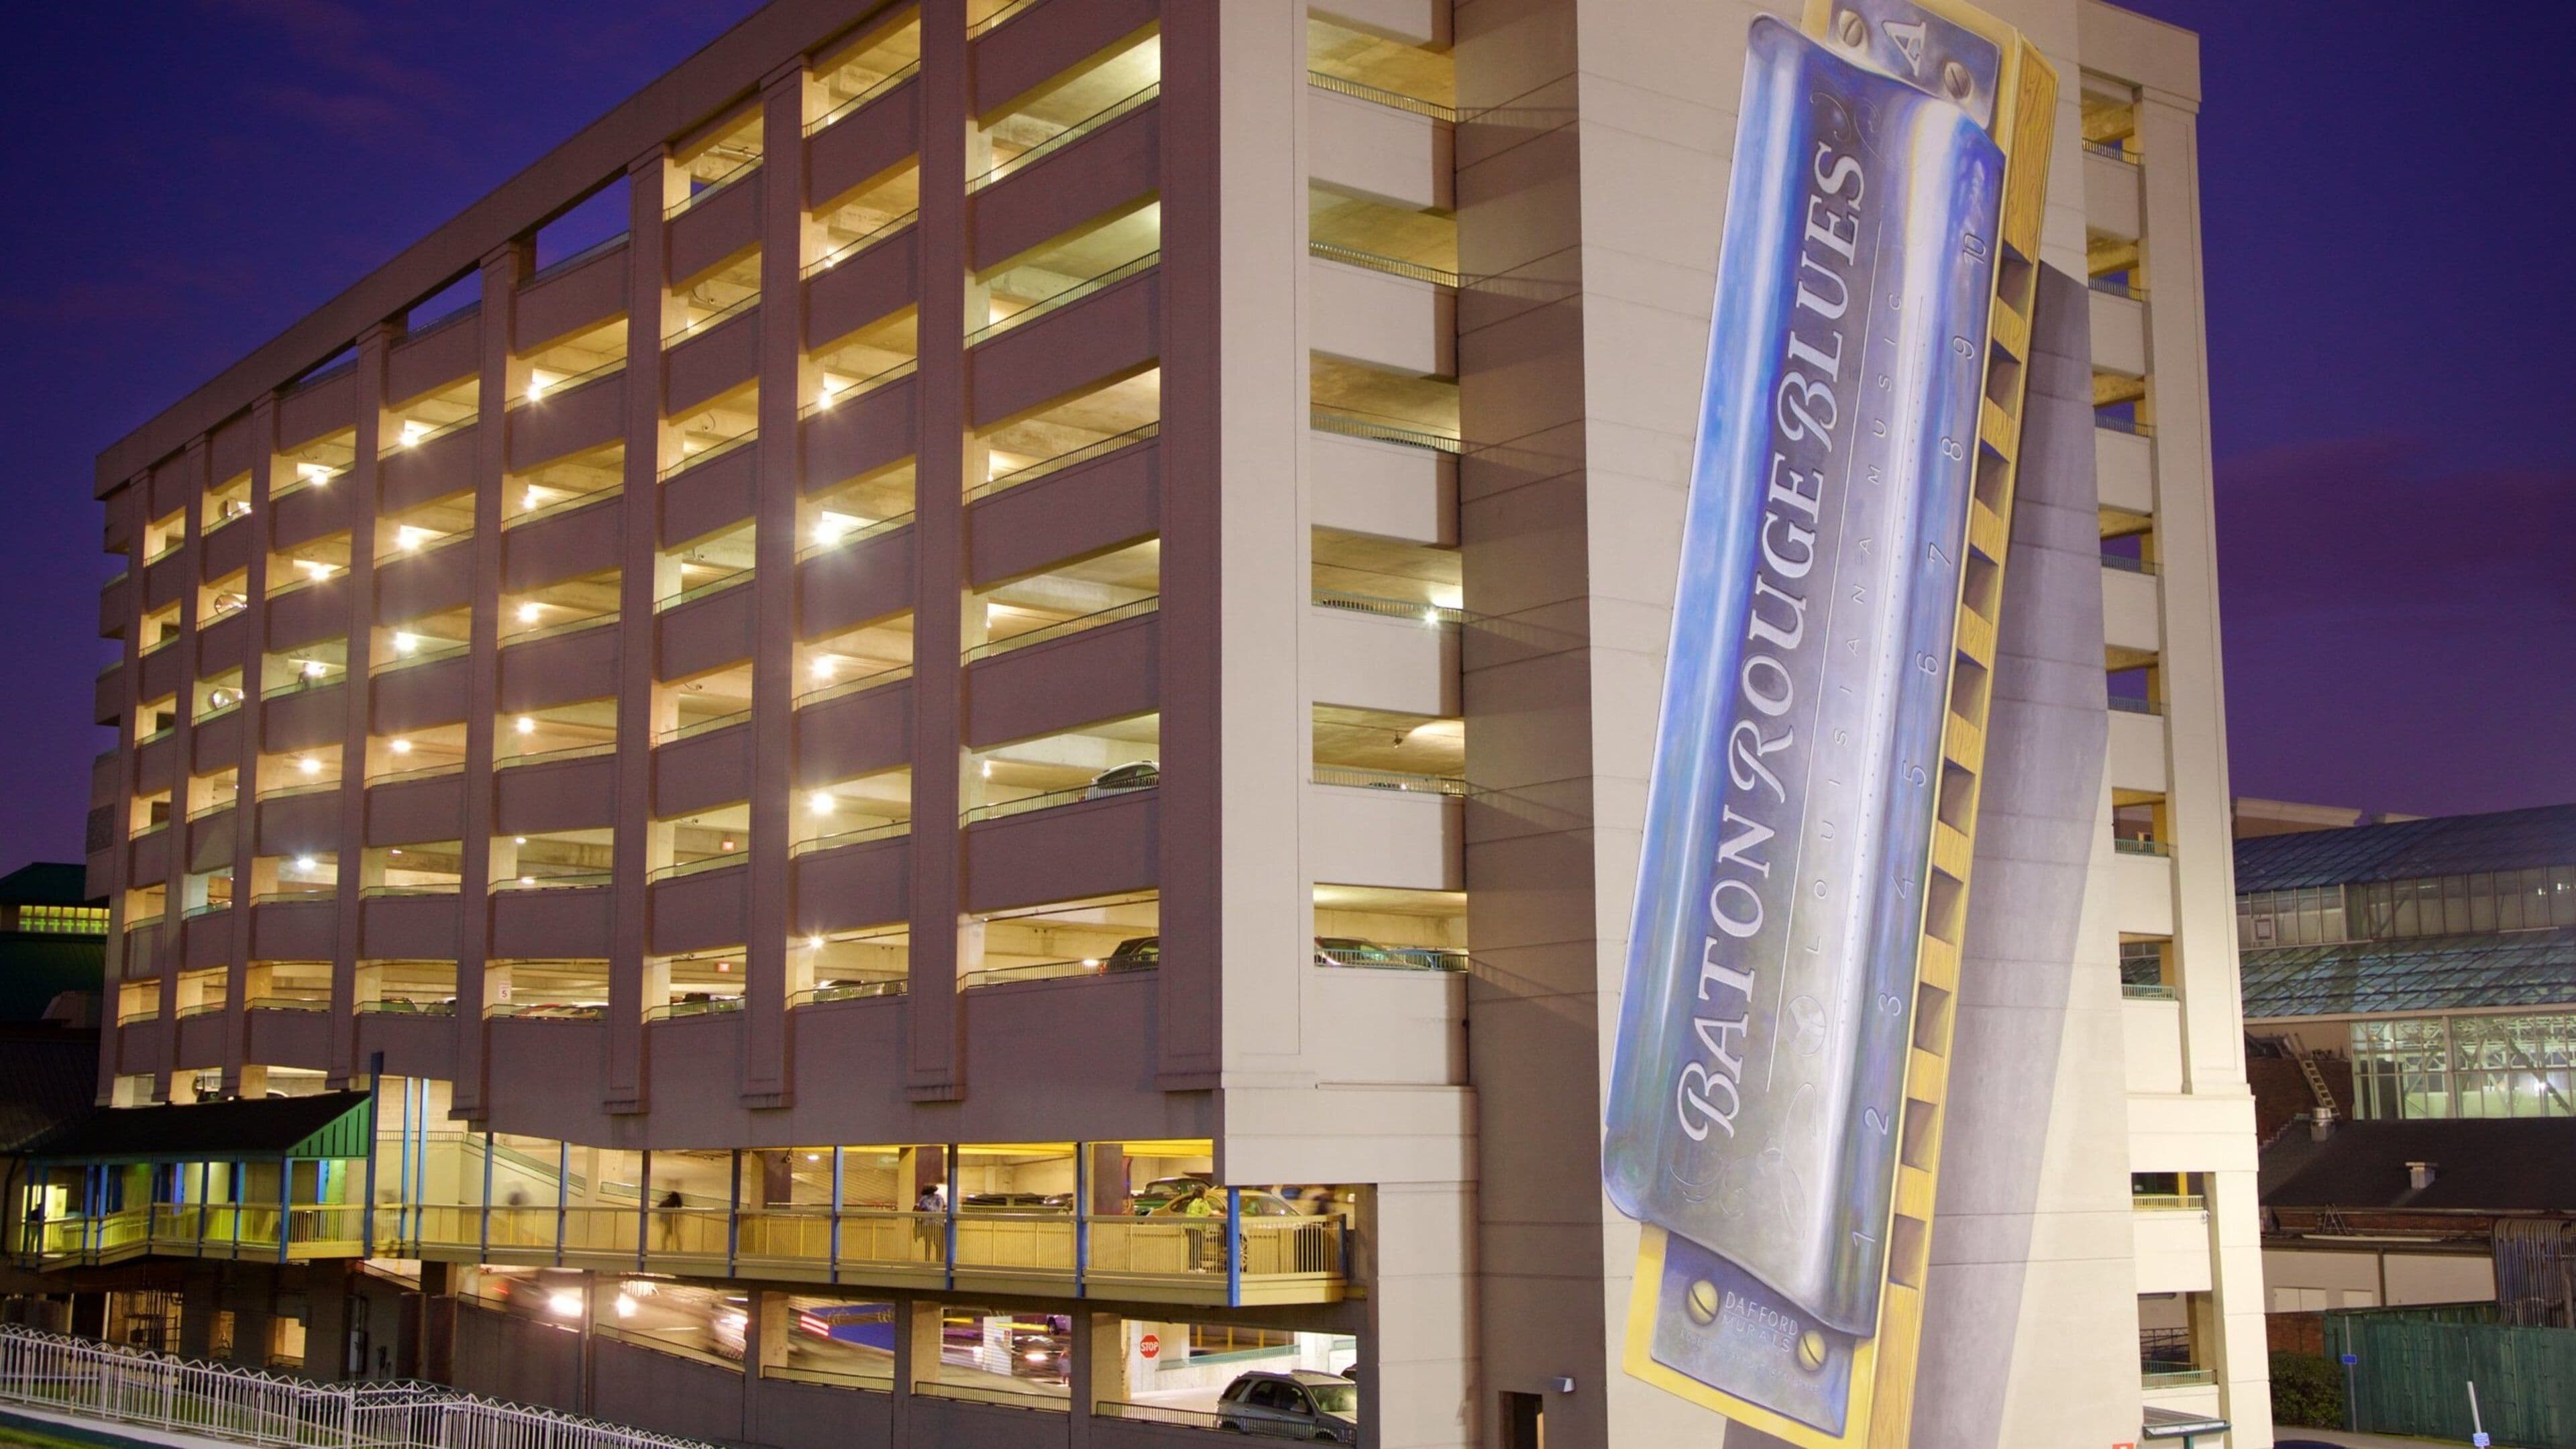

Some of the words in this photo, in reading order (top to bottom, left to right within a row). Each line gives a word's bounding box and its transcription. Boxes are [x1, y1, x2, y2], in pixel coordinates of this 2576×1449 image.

[1881, 19, 1926, 77] A
[1962, 232, 1988, 266] 10
[1952, 335, 1975, 360] 9
[1941, 436, 1964, 462] 8
[1927, 541, 1951, 567] 7
[1805, 537, 1872, 955] LOUISIANA
[1866, 292, 1902, 485] MUSIC
[1677, 804, 1776, 1142] BATON
[1727, 451, 1824, 804] ROUGE
[1776, 141, 1865, 453] BLUES
[1916, 650, 1939, 677] 6
[1901, 759, 1927, 788] 5
[1890, 874, 1915, 900] 4
[1878, 991, 1902, 1018] 3
[1863, 1106, 1889, 1136] 2
[1725, 1290, 1799, 1336] DAFFORD
[1140, 1341, 1159, 1352] STOP
[1721, 1314, 1792, 1353] MURALS
